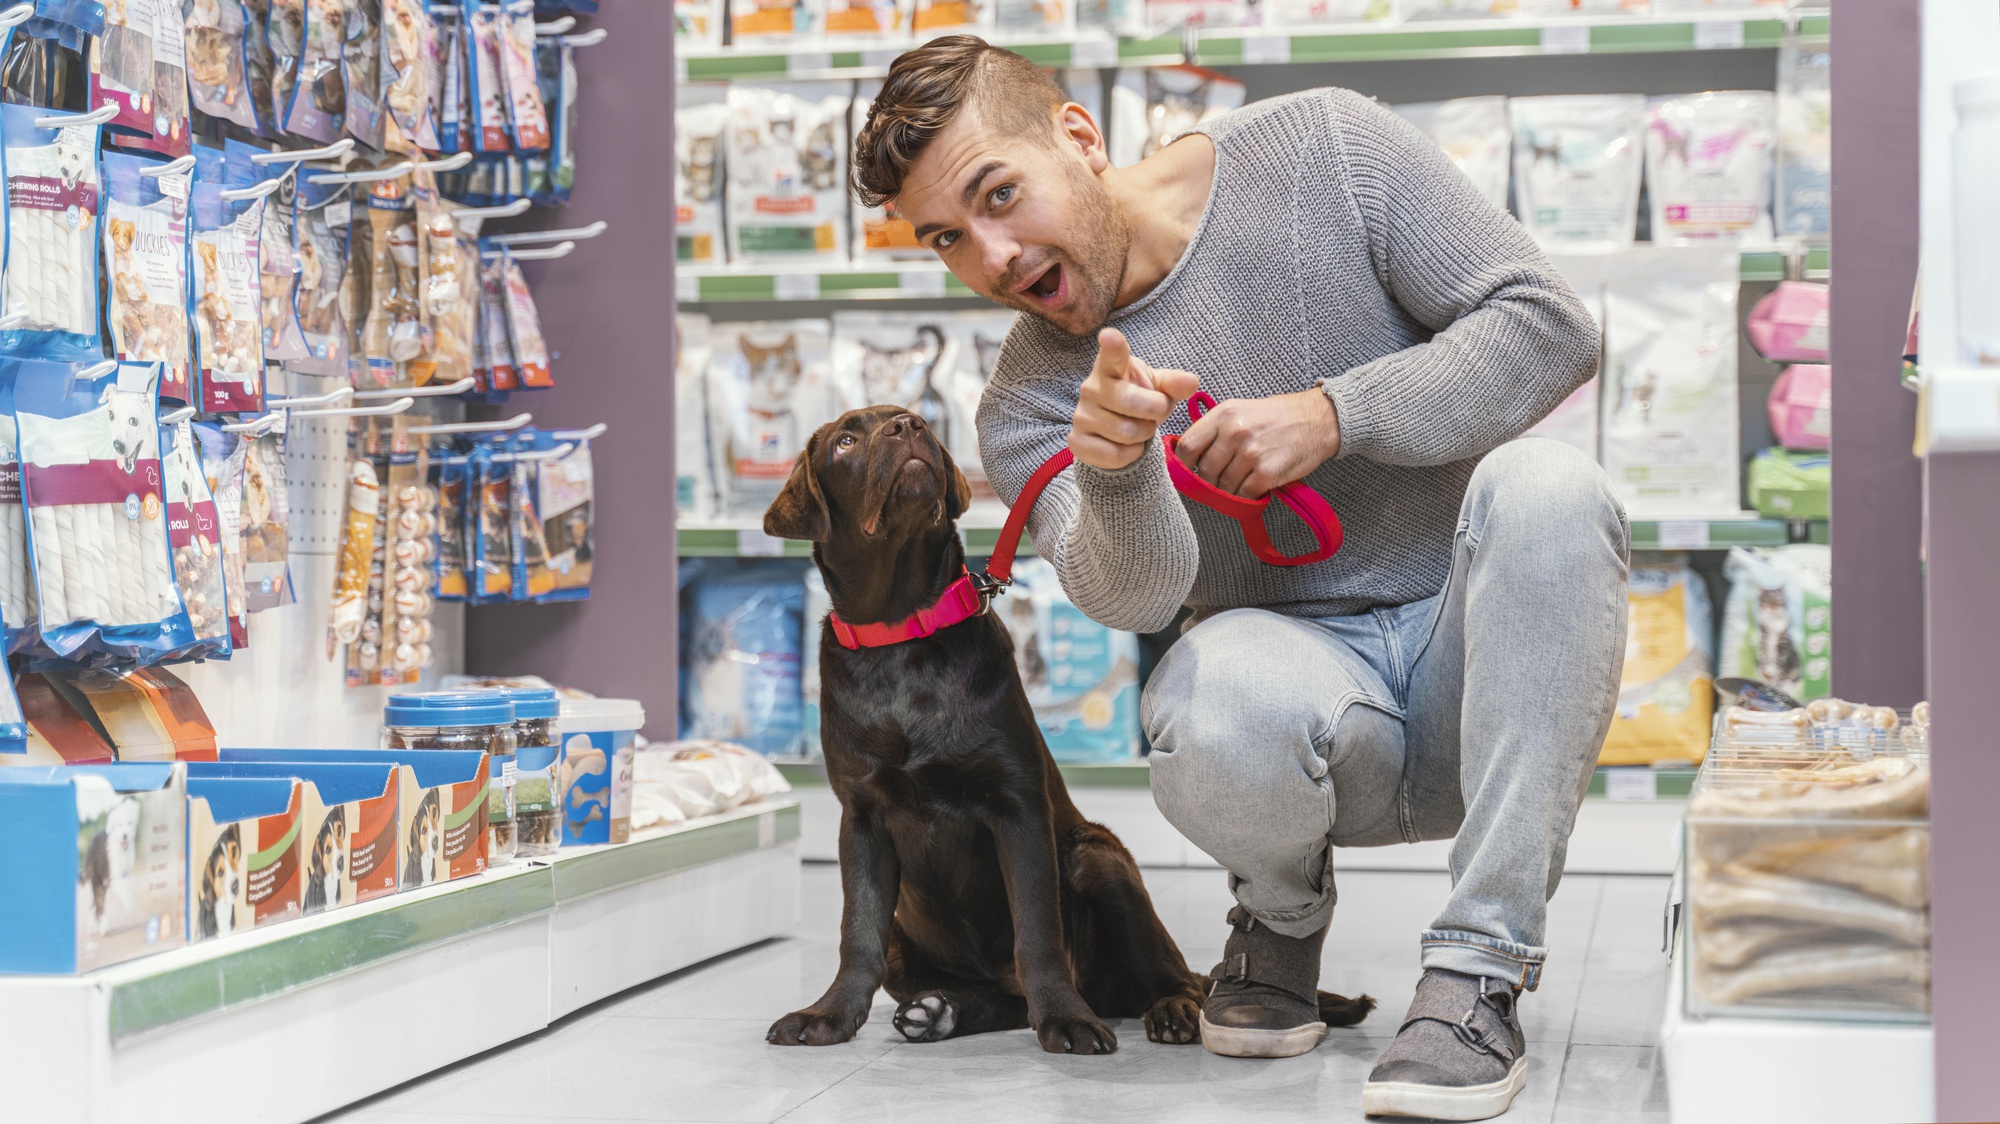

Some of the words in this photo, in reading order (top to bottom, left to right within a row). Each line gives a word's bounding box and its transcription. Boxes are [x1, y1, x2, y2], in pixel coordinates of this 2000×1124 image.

[8, 182, 40, 192] CHEWING
[40, 184, 60, 194] ROLLS
[136, 231, 170, 256] DUCKIES
[218, 251, 246, 272] DUCKIES
[214, 391, 229, 400] 100g
[170, 520, 189, 530] ROLLS
[162, 624, 171, 632] 15
